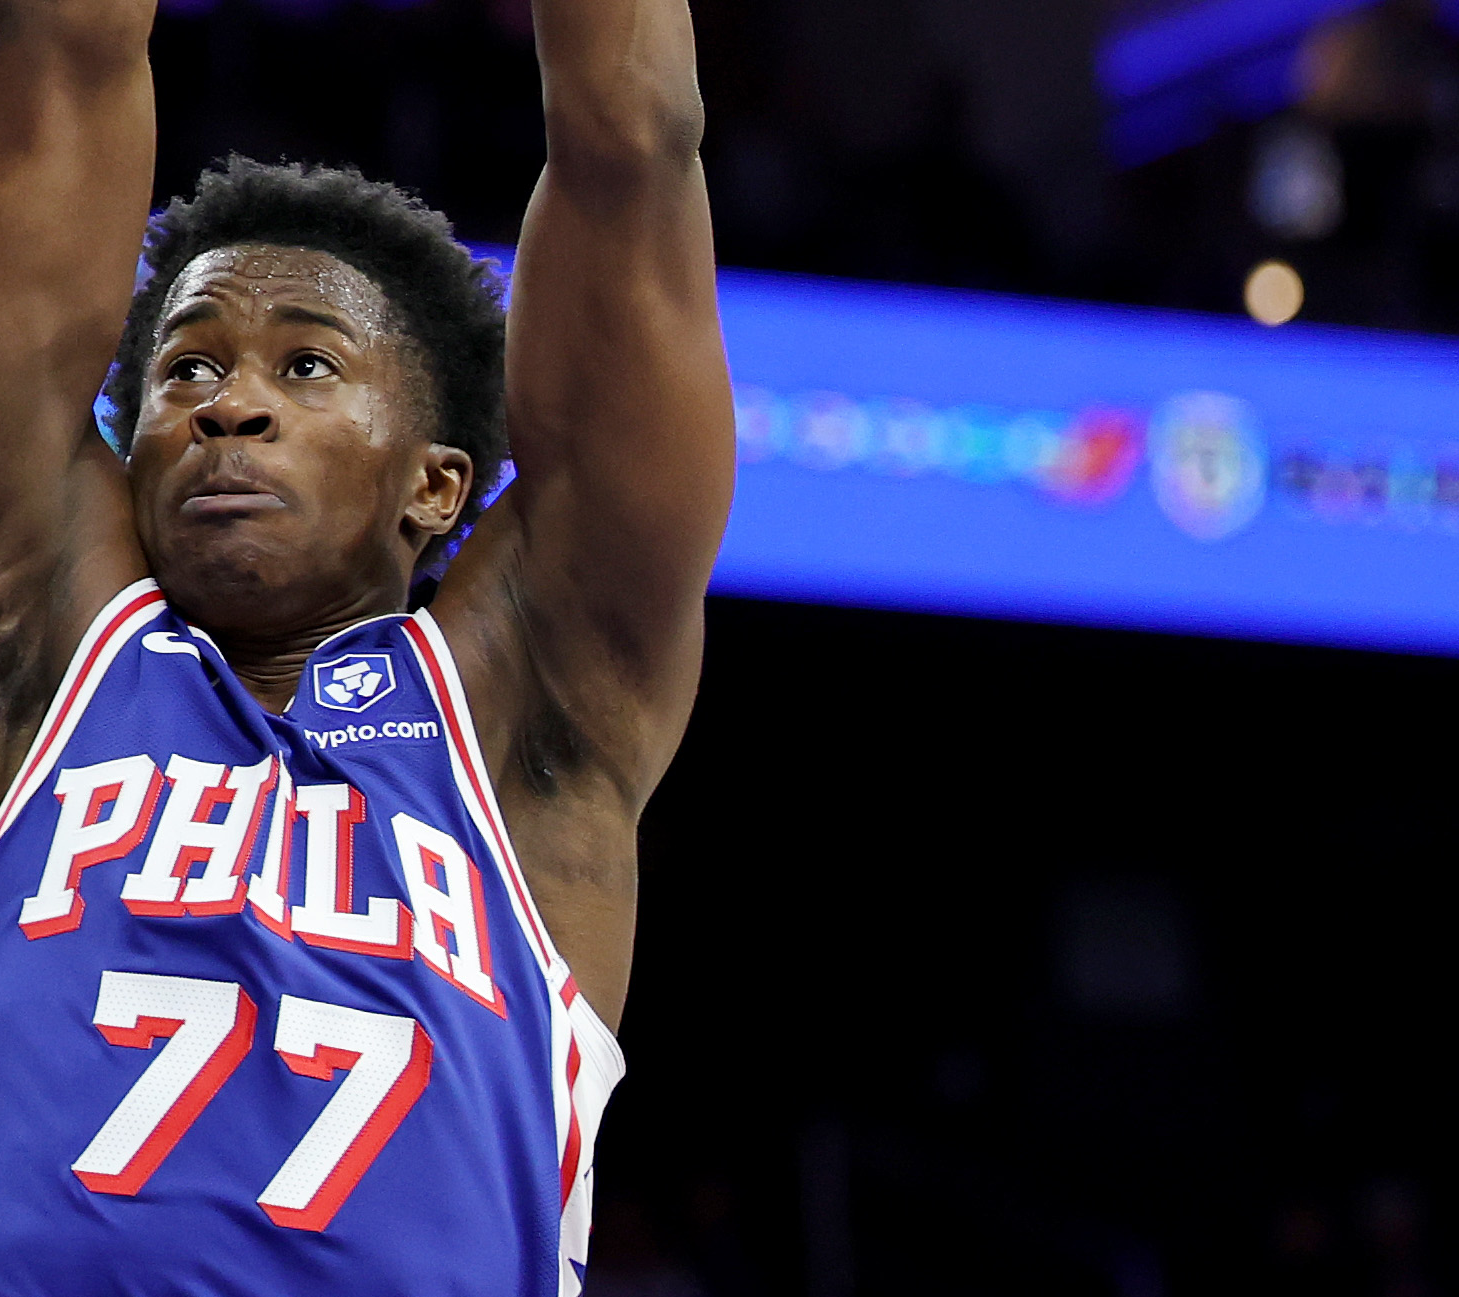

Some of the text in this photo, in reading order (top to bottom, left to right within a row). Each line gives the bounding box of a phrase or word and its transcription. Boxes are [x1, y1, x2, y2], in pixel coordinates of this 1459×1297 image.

[303, 720, 439, 750] rypto.com
[18, 750, 506, 1020] PHILA
[71, 970, 434, 1232] 77
